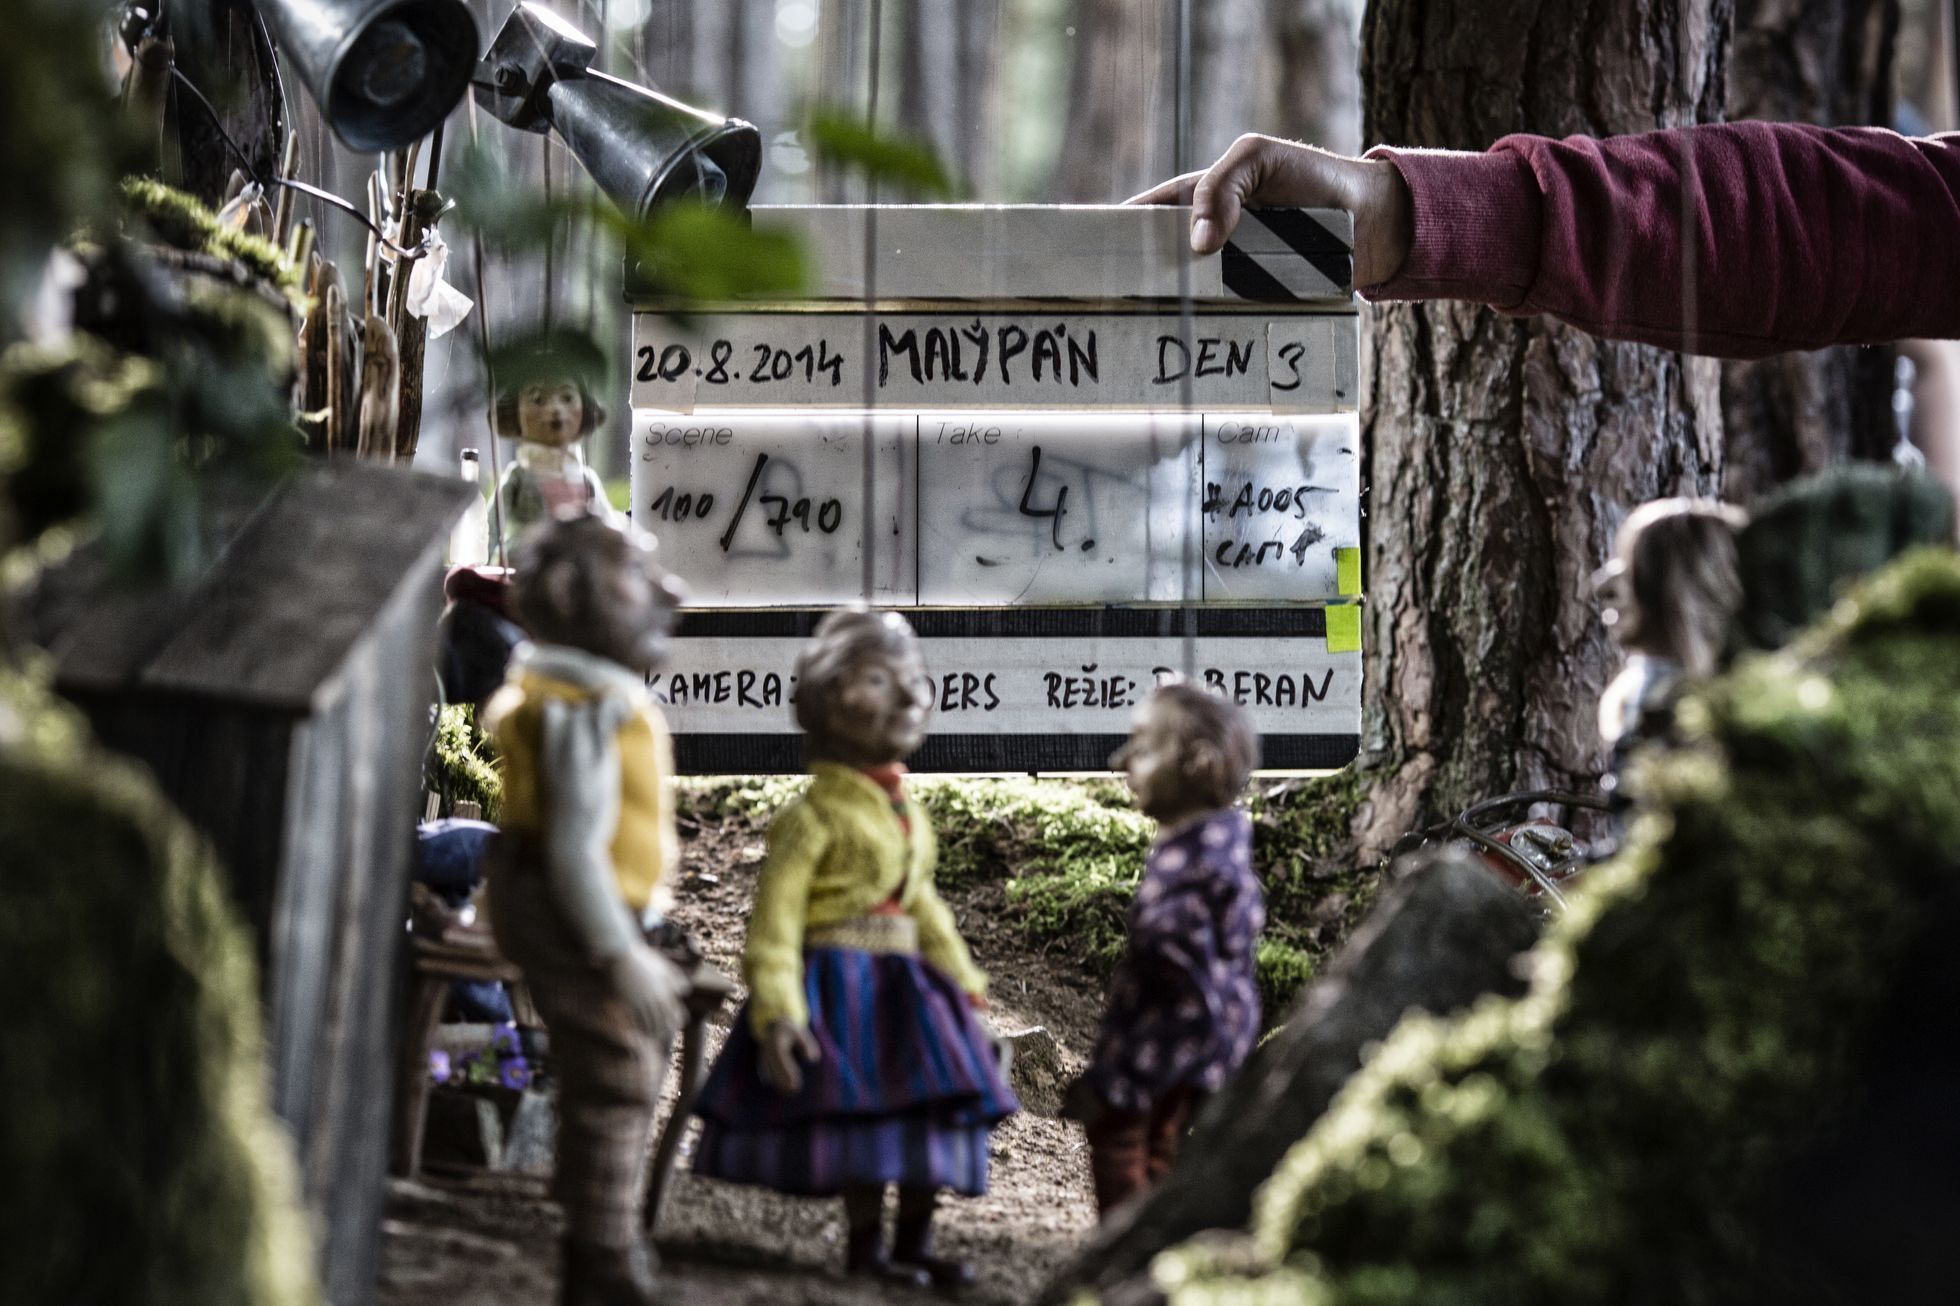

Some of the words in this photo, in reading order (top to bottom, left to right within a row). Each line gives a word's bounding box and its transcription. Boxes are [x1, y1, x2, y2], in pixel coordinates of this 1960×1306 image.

[637, 339, 844, 387] 20.8.2014
[1152, 335, 1254, 386] DEN
[645, 422, 733, 447] Scene
[936, 421, 1001, 445] Take
[1217, 421, 1280, 444] Cam
